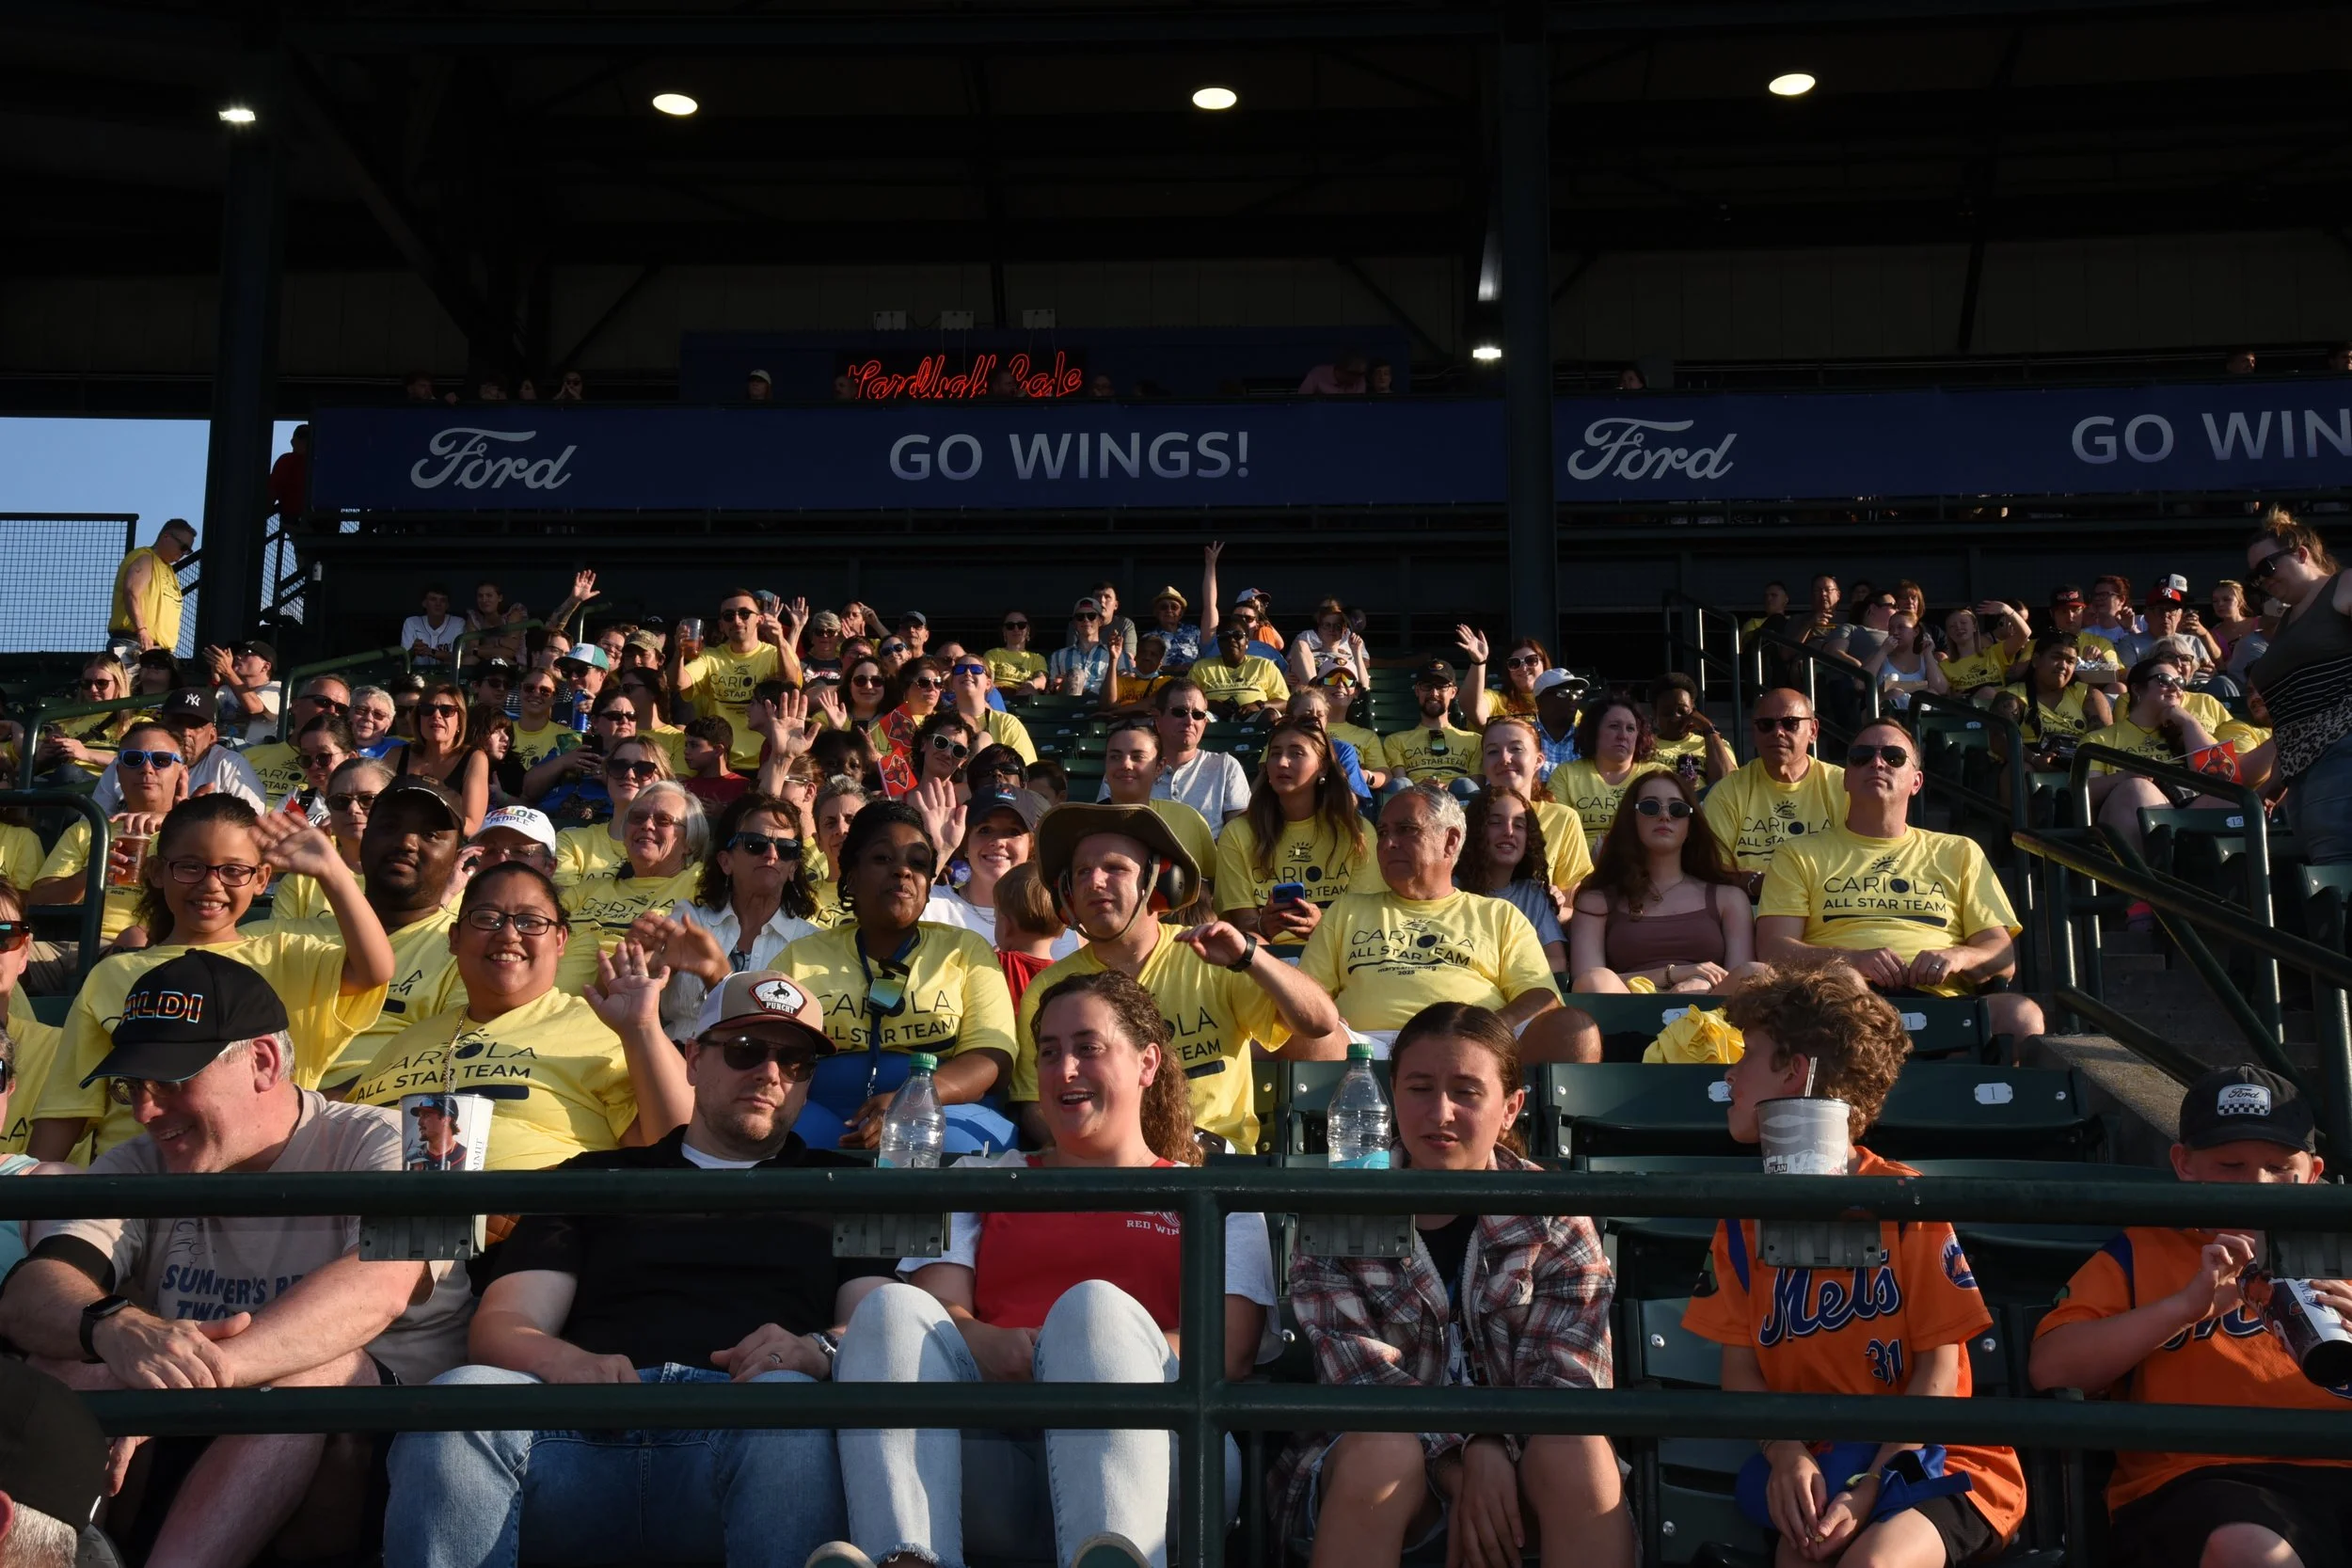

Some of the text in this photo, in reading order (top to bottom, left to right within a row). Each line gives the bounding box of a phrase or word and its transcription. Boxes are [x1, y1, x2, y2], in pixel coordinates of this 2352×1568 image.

[2071, 410, 2352, 466] GO WIN
[410, 427, 578, 489] Ford
[889, 431, 1248, 481] GO WINGS!
[1567, 418, 1738, 481] Ford
[709, 673, 757, 689] CARIOL
[185, 693, 200, 707] NY
[1404, 746, 1469, 760] CAROLA
[252, 767, 309, 784] ARIOL
[262, 780, 288, 791] STAR
[490, 816, 529, 826] PEOPLE
[1582, 814, 1614, 824] LL ST
[1741, 816, 1833, 835] CARIOLA
[1738, 835, 1795, 847] ALL STA
[1252, 863, 1350, 884] CARIOLA
[1824, 877, 1947, 898] CARIOLA
[1823, 897, 1947, 913] ALL STAR TEAM
[1352, 928, 1475, 952] CARIOLA
[1347, 944, 1470, 966] ALL STAR EAM
[119, 990, 203, 1024] ALDI
[766, 1002, 795, 1014] PUNCHY
[824, 1026, 847, 1041] LL
[901, 1017, 956, 1041] TEAM
[1177, 1037, 1221, 1060] EAM
[356, 1080, 387, 1104] ALL
[464, 1064, 531, 1080] TEAM
[1990, 1085, 1996, 1101] 1
[2228, 1087, 2260, 1099] Ford
[472, 1138, 484, 1171] MMIT
[1126, 1220, 1180, 1235] RED WIN
[1757, 1265, 1901, 1347] Mets
[1865, 1338, 1902, 1385] 31
